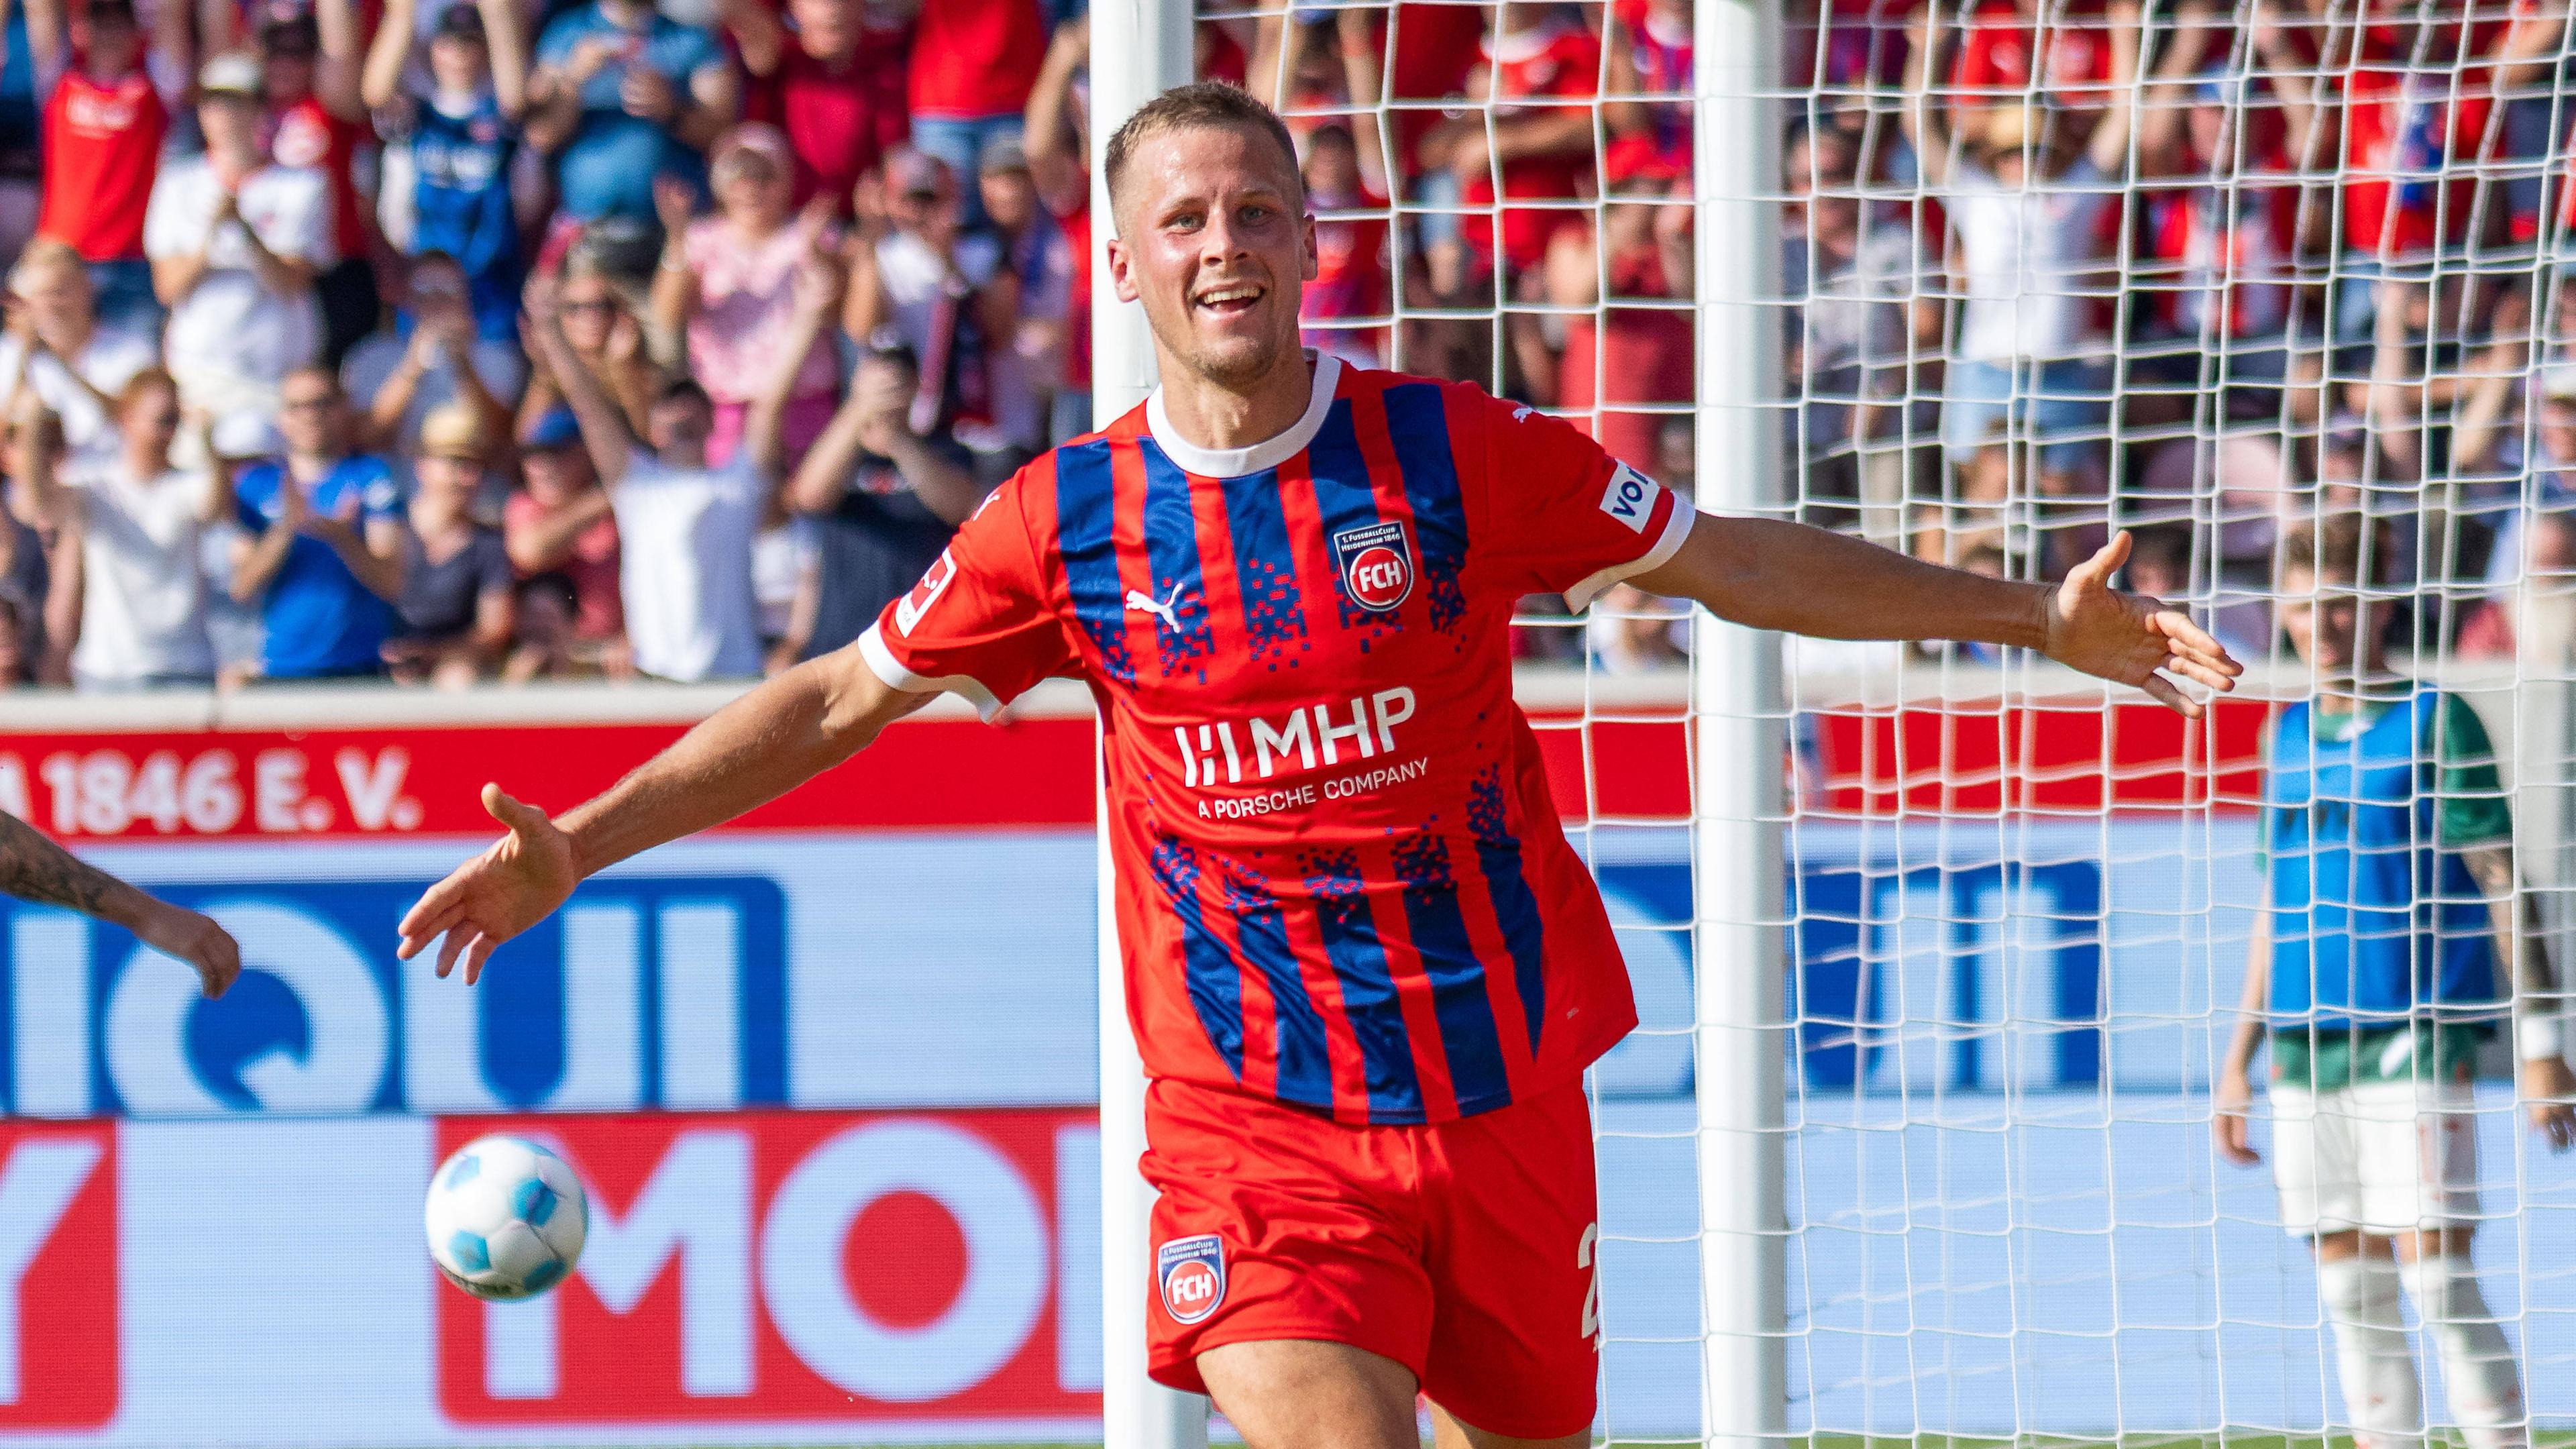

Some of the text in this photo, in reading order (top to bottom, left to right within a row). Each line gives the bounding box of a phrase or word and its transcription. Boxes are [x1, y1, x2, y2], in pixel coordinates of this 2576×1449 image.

[1612, 466, 1650, 518] VOI
[1341, 533, 1401, 553] HEIDENHEIM 1846
[1358, 561, 1402, 593] FCH
[1249, 686, 1417, 778] MHP
[39, 747, 247, 835] 1846
[254, 747, 335, 833] E.
[333, 745, 426, 832] V.
[1198, 756, 1429, 819] A PORSCHE COMPANY
[1172, 1274, 1213, 1305] FCH
